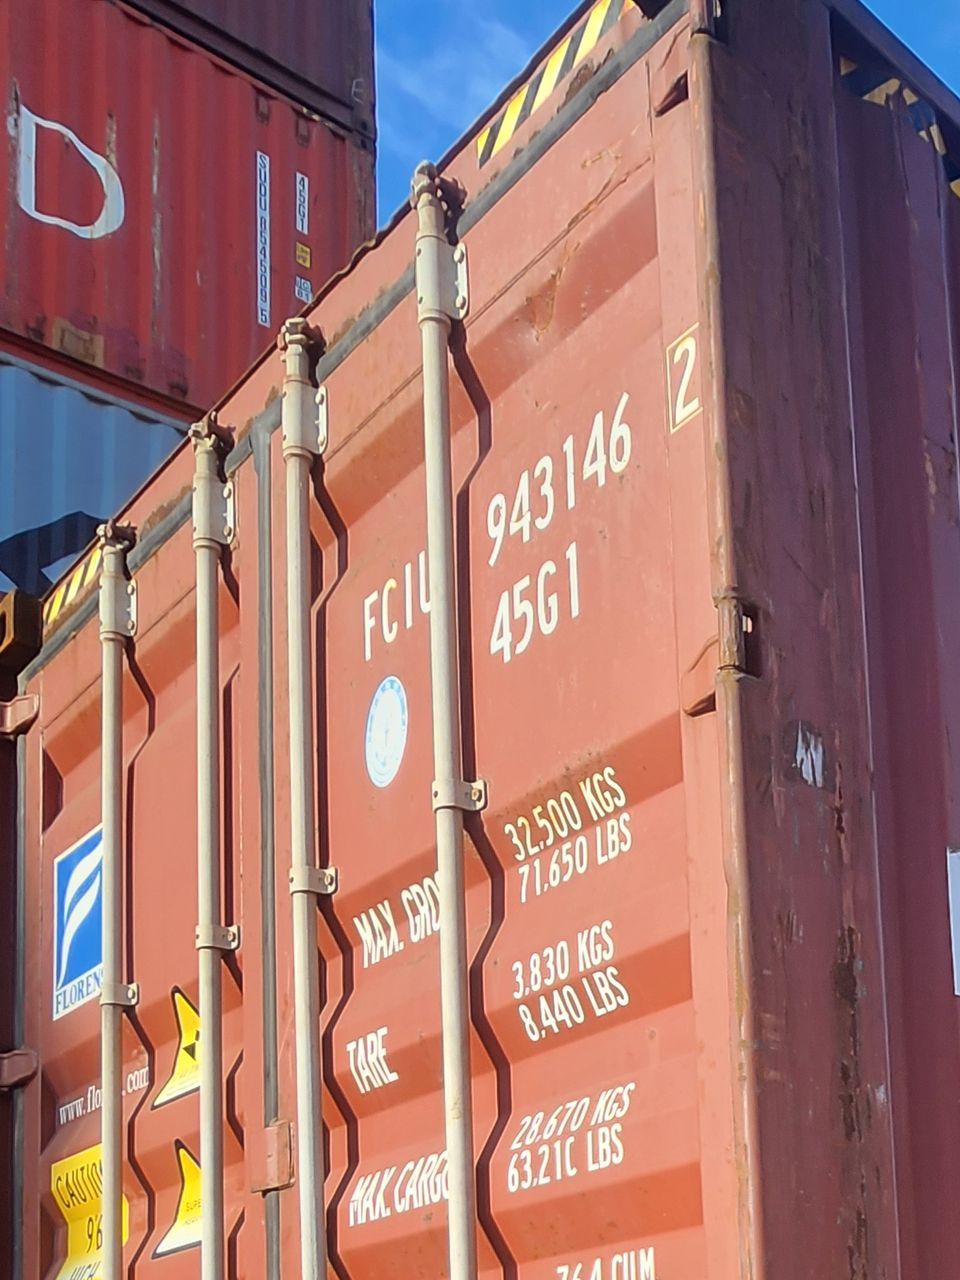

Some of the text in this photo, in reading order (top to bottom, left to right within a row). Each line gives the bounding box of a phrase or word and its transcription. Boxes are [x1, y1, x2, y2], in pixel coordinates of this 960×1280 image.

[258, 154, 268, 212] SUDU
[298, 176, 306, 232] 45G1
[672, 335, 700, 423] 2
[488, 392, 632, 567] 943146
[489, 542, 580, 664] 45G1
[504, 766, 626, 861] 32,500 KGS
[518, 812, 632, 903] 71,650 LBS
[353, 871, 442, 968] MAX. GRO
[511, 919, 614, 999] 3,830 KGS
[518, 966, 630, 1041] 8,440 LBS
[59, 1066, 150, 1126] www.flo.com
[346, 1026, 400, 1094] TARE
[510, 1082, 636, 1151] 28,670 KGS
[586, 1122, 624, 1172] LBS
[349, 1165, 397, 1228] MAX.
